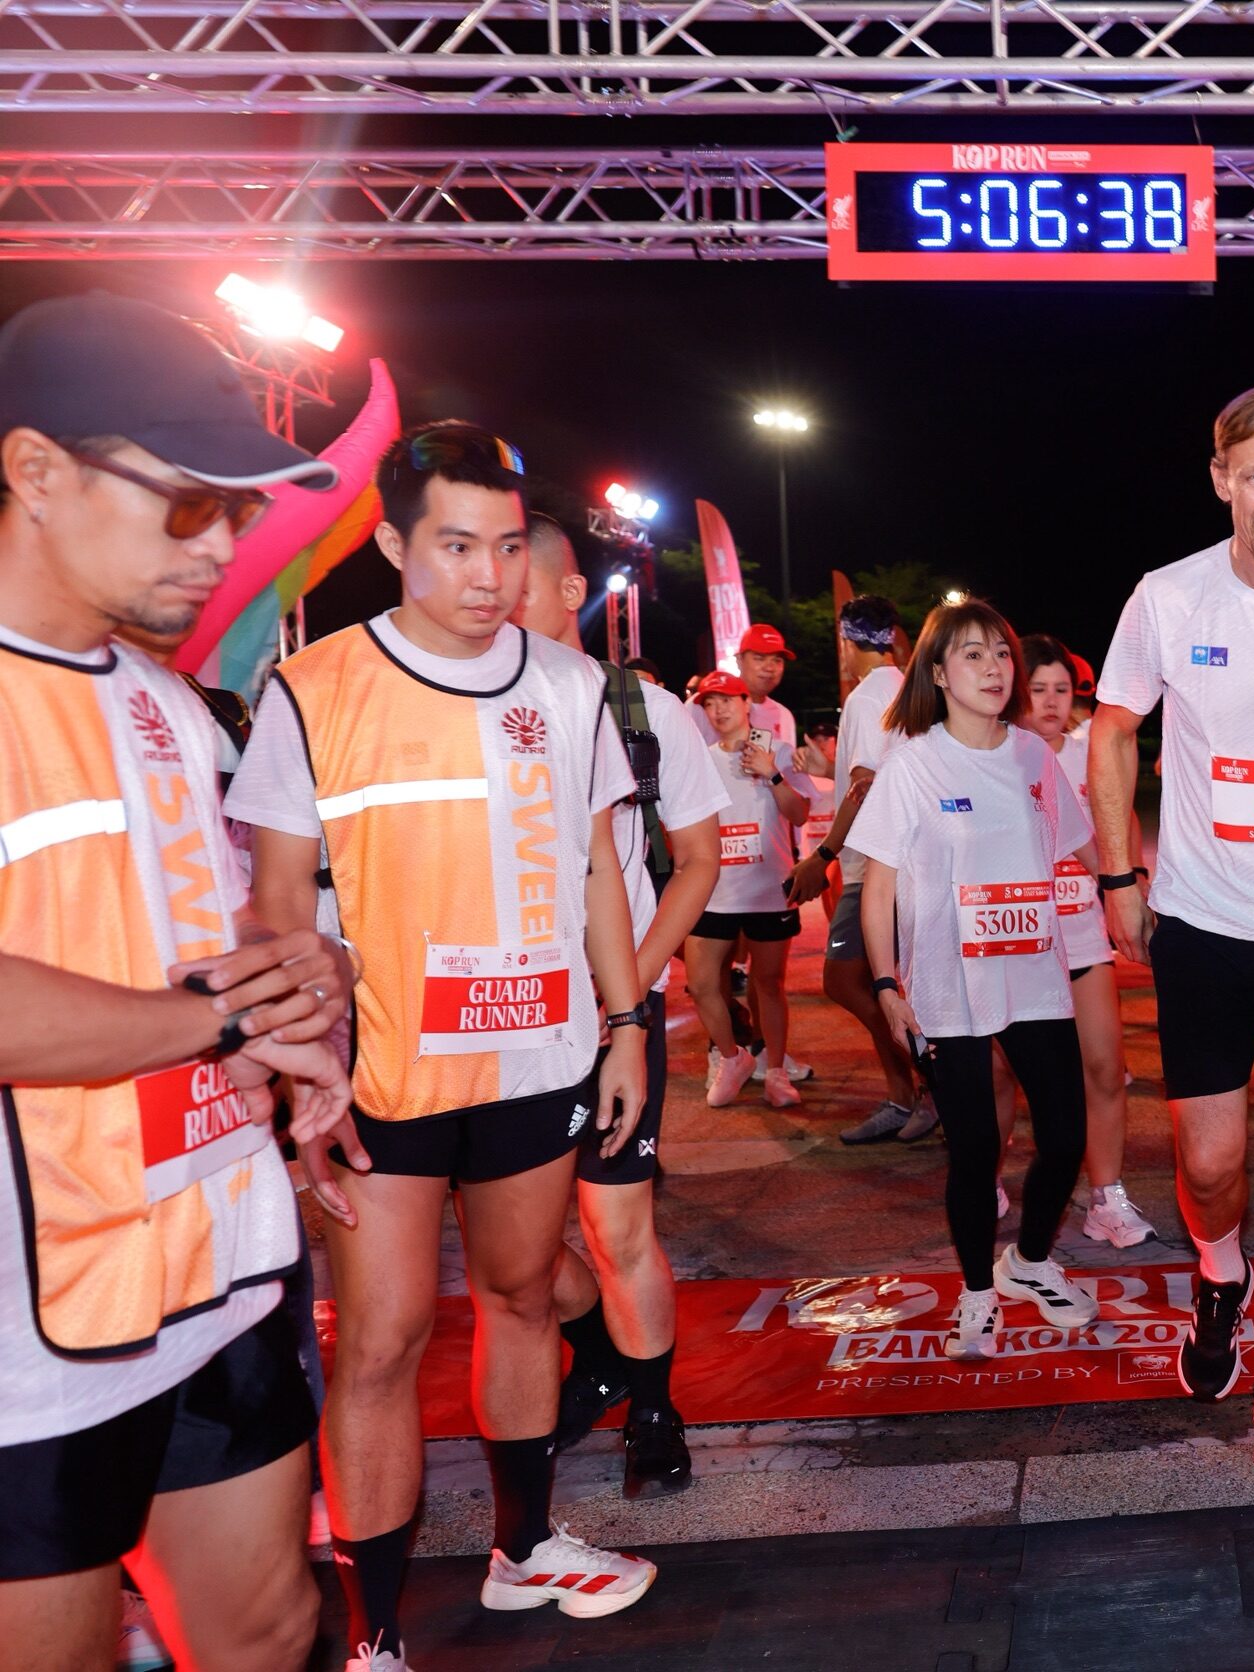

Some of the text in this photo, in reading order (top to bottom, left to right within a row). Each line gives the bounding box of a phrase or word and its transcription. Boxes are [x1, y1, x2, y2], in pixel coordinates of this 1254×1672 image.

[952, 144, 999, 170] KOP
[1000, 145, 1047, 171] RUN
[912, 178, 1184, 249] 5:06:38
[974, 907, 1039, 936] 53018
[441, 956, 480, 966] KOP RUN
[504, 953, 512, 964] 5
[468, 977, 543, 1004] GUARD
[458, 1002, 547, 1031] RUNNER
[842, 1322, 1098, 1361] BANKOK
[816, 1364, 1101, 1391] PRESENTED BY
